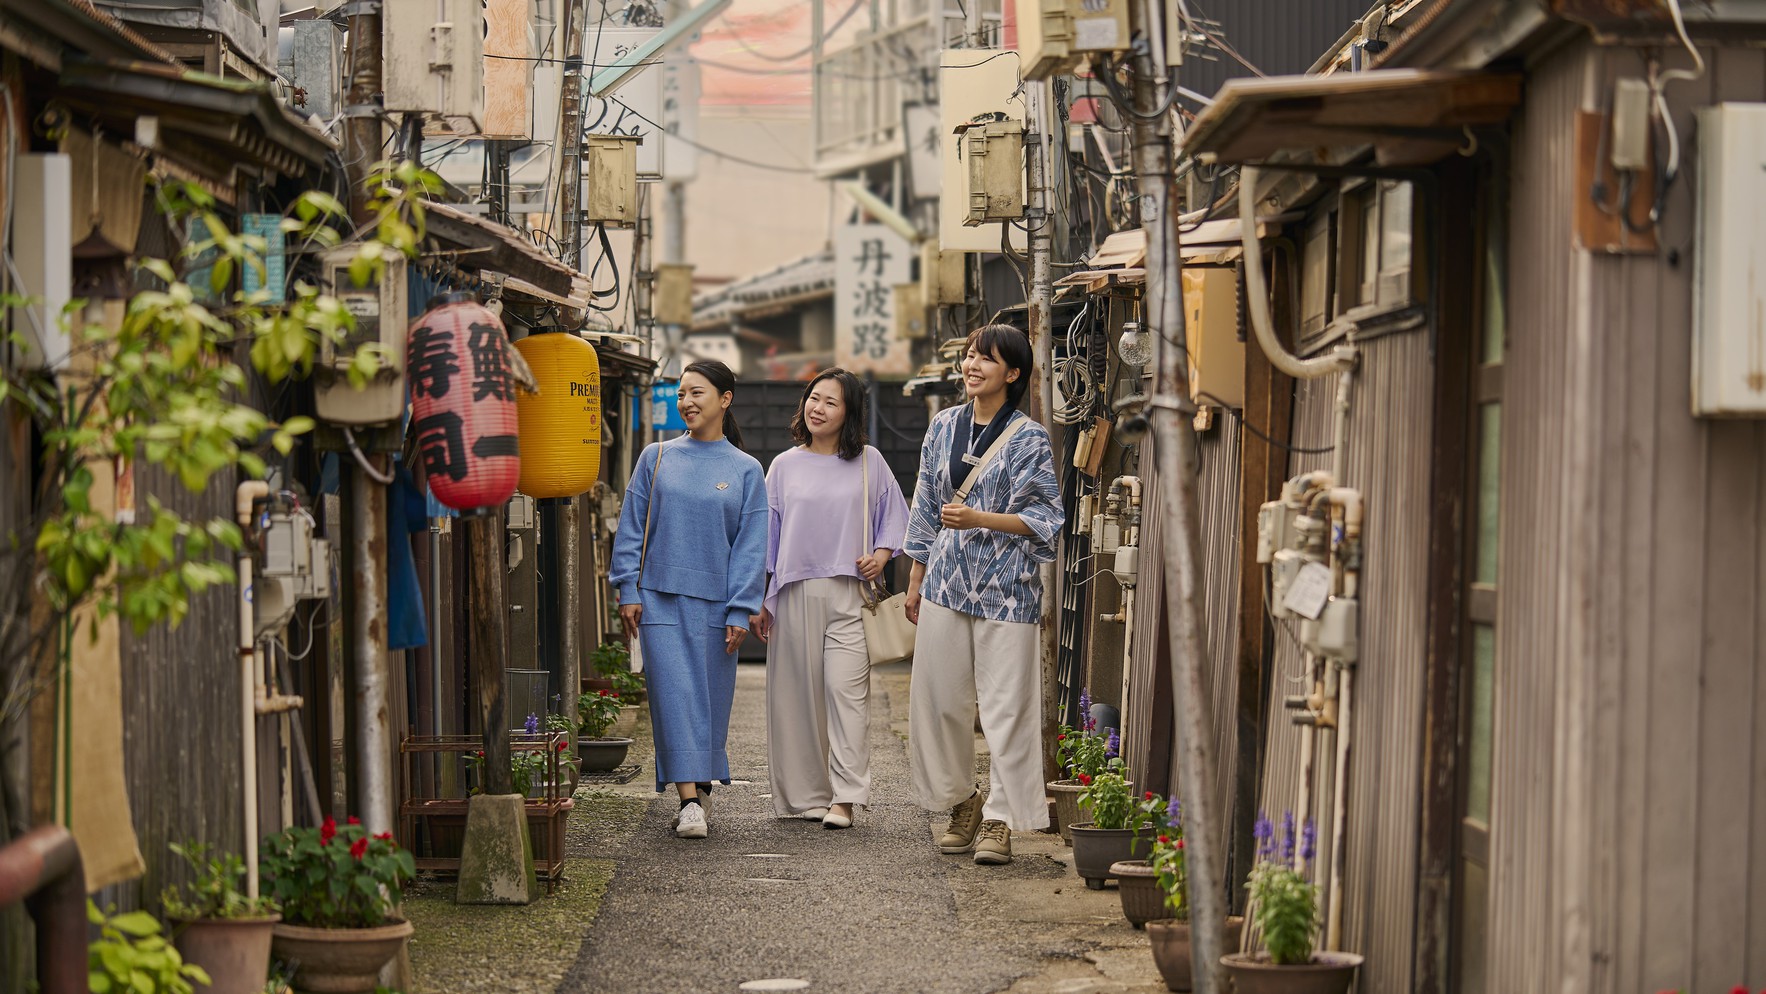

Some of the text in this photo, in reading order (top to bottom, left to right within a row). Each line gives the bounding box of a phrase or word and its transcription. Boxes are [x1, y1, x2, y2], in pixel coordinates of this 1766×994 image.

[853, 239, 891, 359] 丹波路
[407, 327, 468, 482] 寿司
